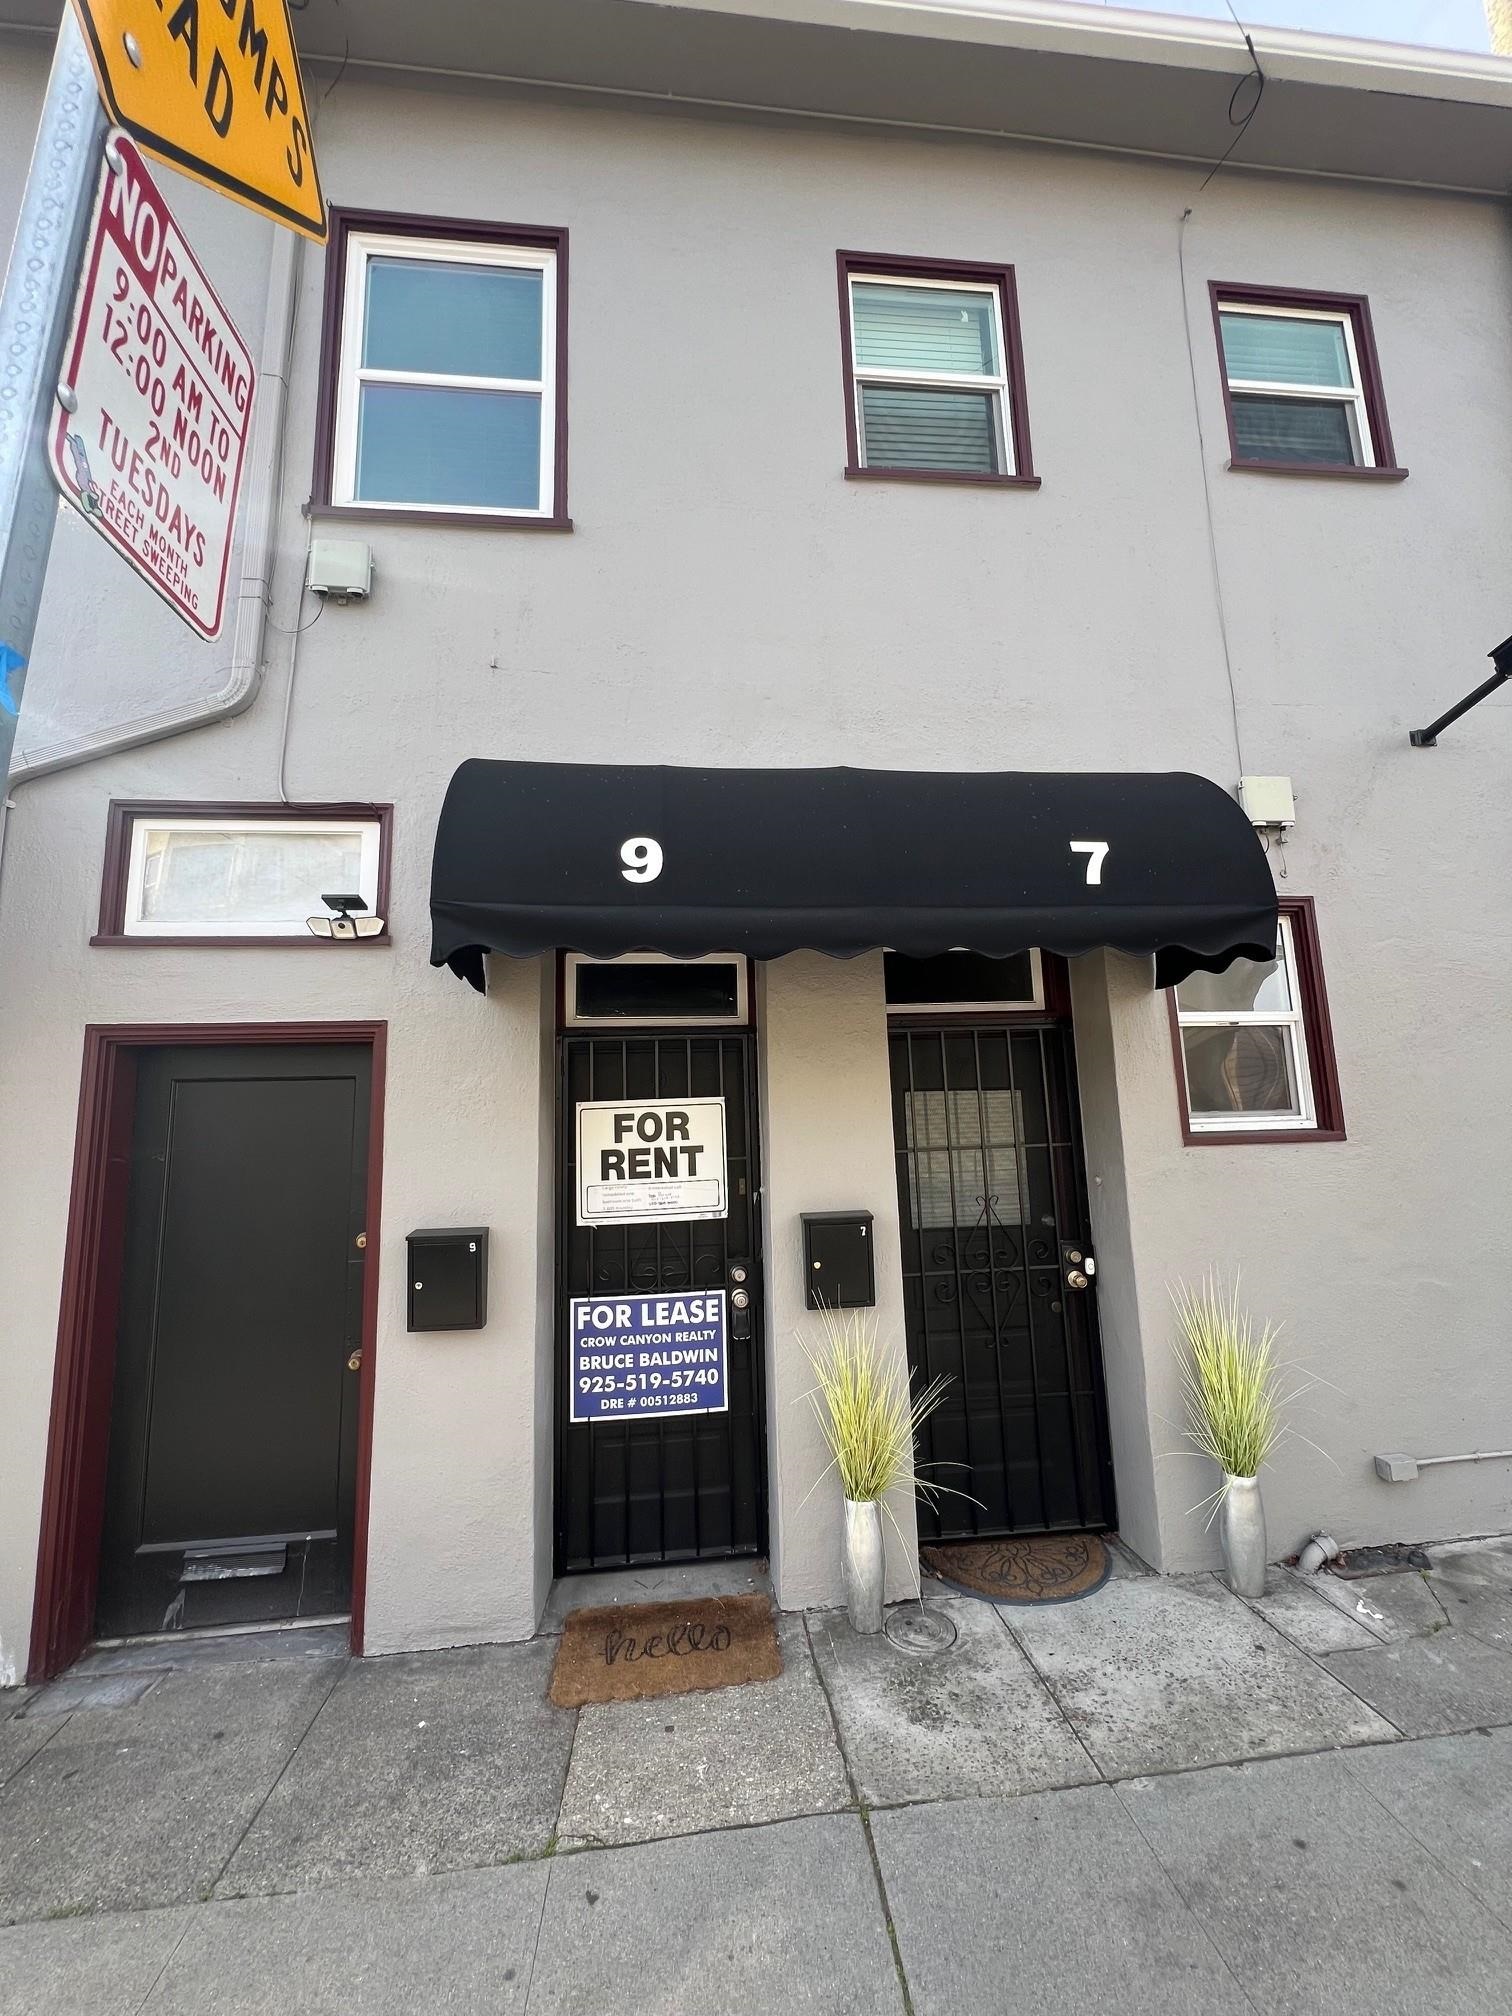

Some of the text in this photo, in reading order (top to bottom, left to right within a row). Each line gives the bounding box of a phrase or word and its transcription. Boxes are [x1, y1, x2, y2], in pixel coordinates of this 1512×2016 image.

[108, 168, 249, 413] NO PARKING
[112, 267, 230, 463] 9:00 AM TO
[102, 303, 227, 504] 12:00 NOON
[144, 420, 182, 480] 2ND
[98, 407, 206, 567] TUESDAYS
[89, 479, 199, 611] STREET SWEEPING
[109, 479, 189, 578] EACH MONTH
[619, 837, 664, 884] 9
[1069, 841, 1110, 885] 7
[613, 1111, 690, 1144] FOR
[600, 1145, 704, 1181] RENT
[469, 1242, 476, 1252] 9
[860, 1226, 866, 1237] 7
[577, 1299, 719, 1330] FOR LEASE
[579, 1348, 718, 1370] BRUCE BALDWIN
[580, 1329, 717, 1347] CROW CANYON REALTY
[578, 1368, 719, 1393] 925-519-5740
[600, 1393, 698, 1409] DRE # 00512883
[598, 1623, 731, 1666] hello
